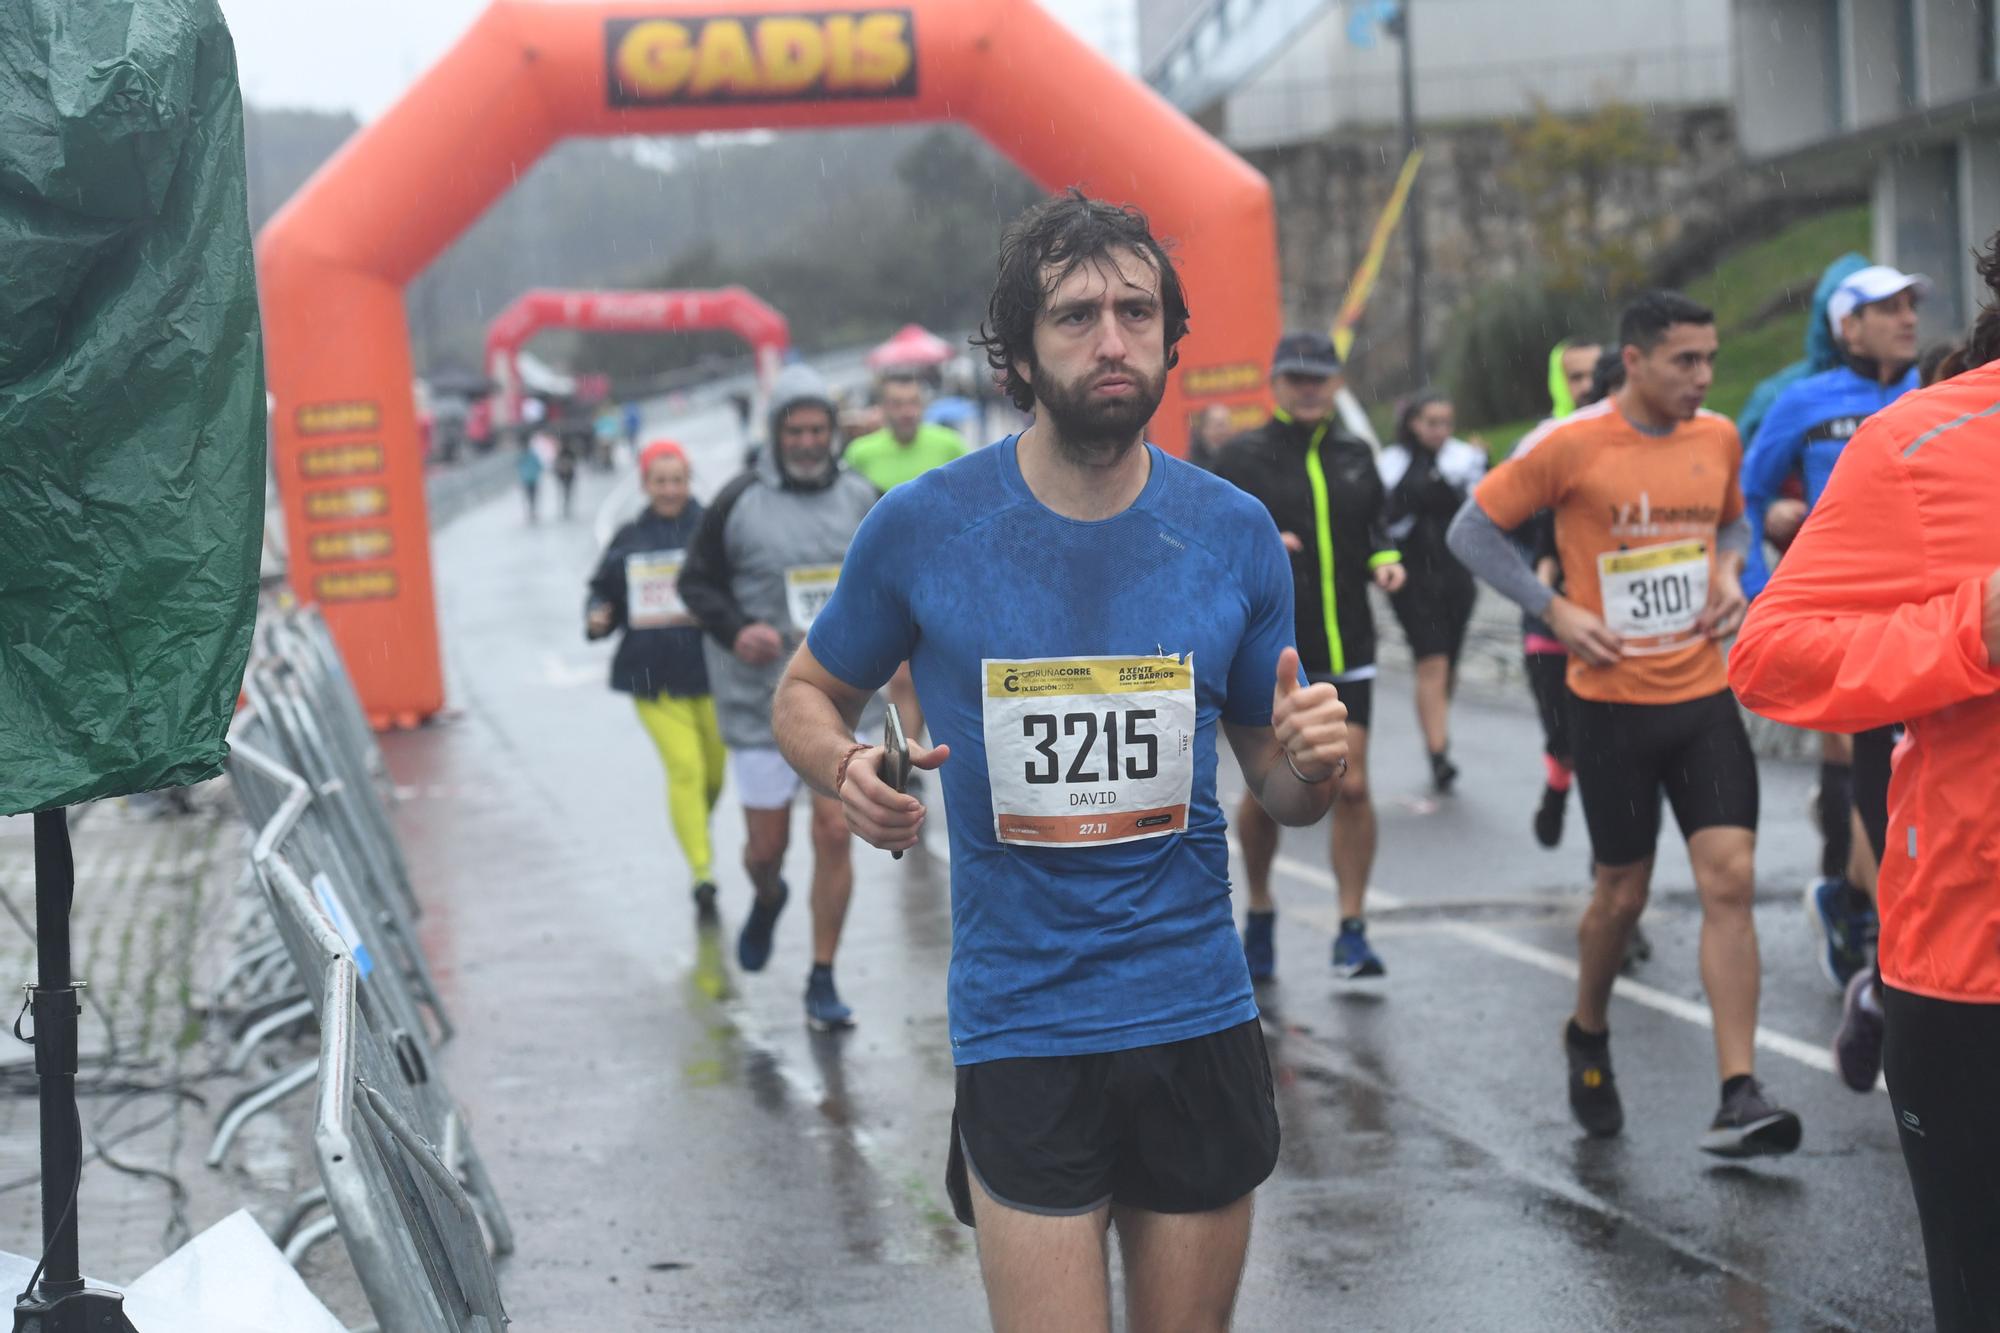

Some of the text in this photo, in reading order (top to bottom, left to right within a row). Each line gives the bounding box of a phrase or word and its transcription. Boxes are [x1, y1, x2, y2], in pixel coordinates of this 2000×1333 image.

[616, 11, 912, 99] GADIS
[1629, 574, 1692, 620] 3101
[1126, 666, 1153, 674] XENTE
[1138, 672, 1175, 680] BARRIOS
[1023, 709, 1158, 784] 3215
[1070, 791, 1117, 806] DAVID
[1078, 822, 1107, 835] 27.11
